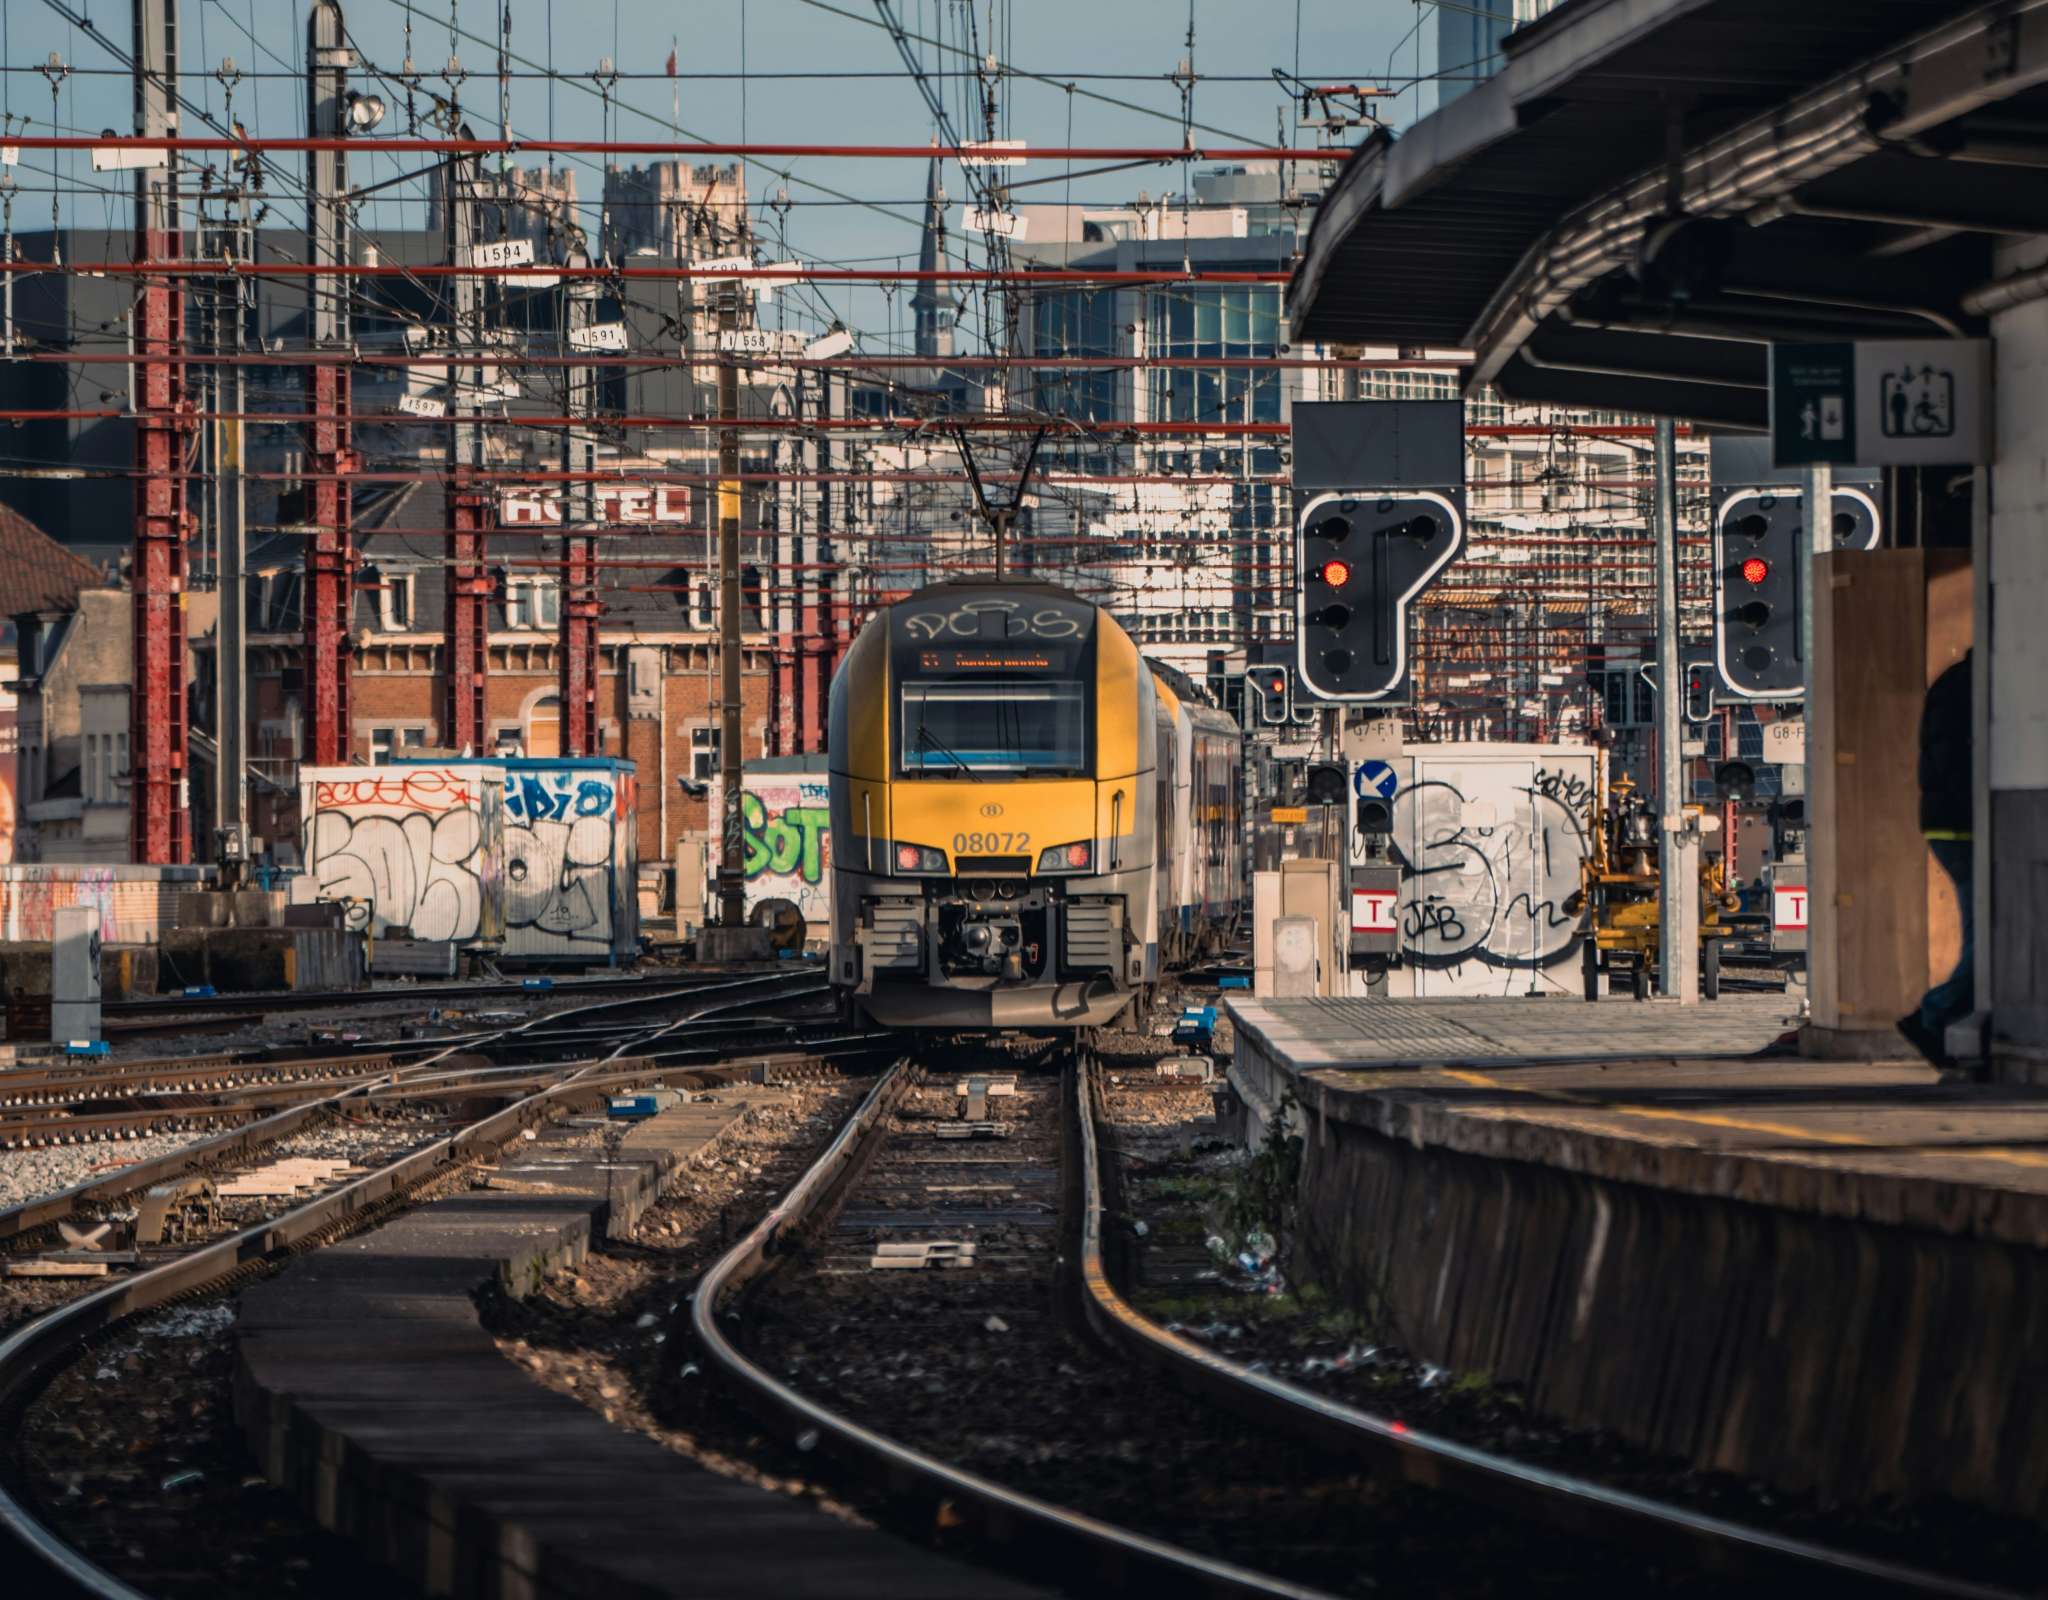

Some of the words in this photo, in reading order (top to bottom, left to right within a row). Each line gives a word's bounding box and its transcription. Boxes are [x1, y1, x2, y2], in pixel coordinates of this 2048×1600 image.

[483, 245, 521, 263] 1594
[582, 330, 615, 344] 1591
[952, 831, 1031, 853] 08072
[1367, 900, 1382, 922] T
[1790, 897, 1805, 920] T
